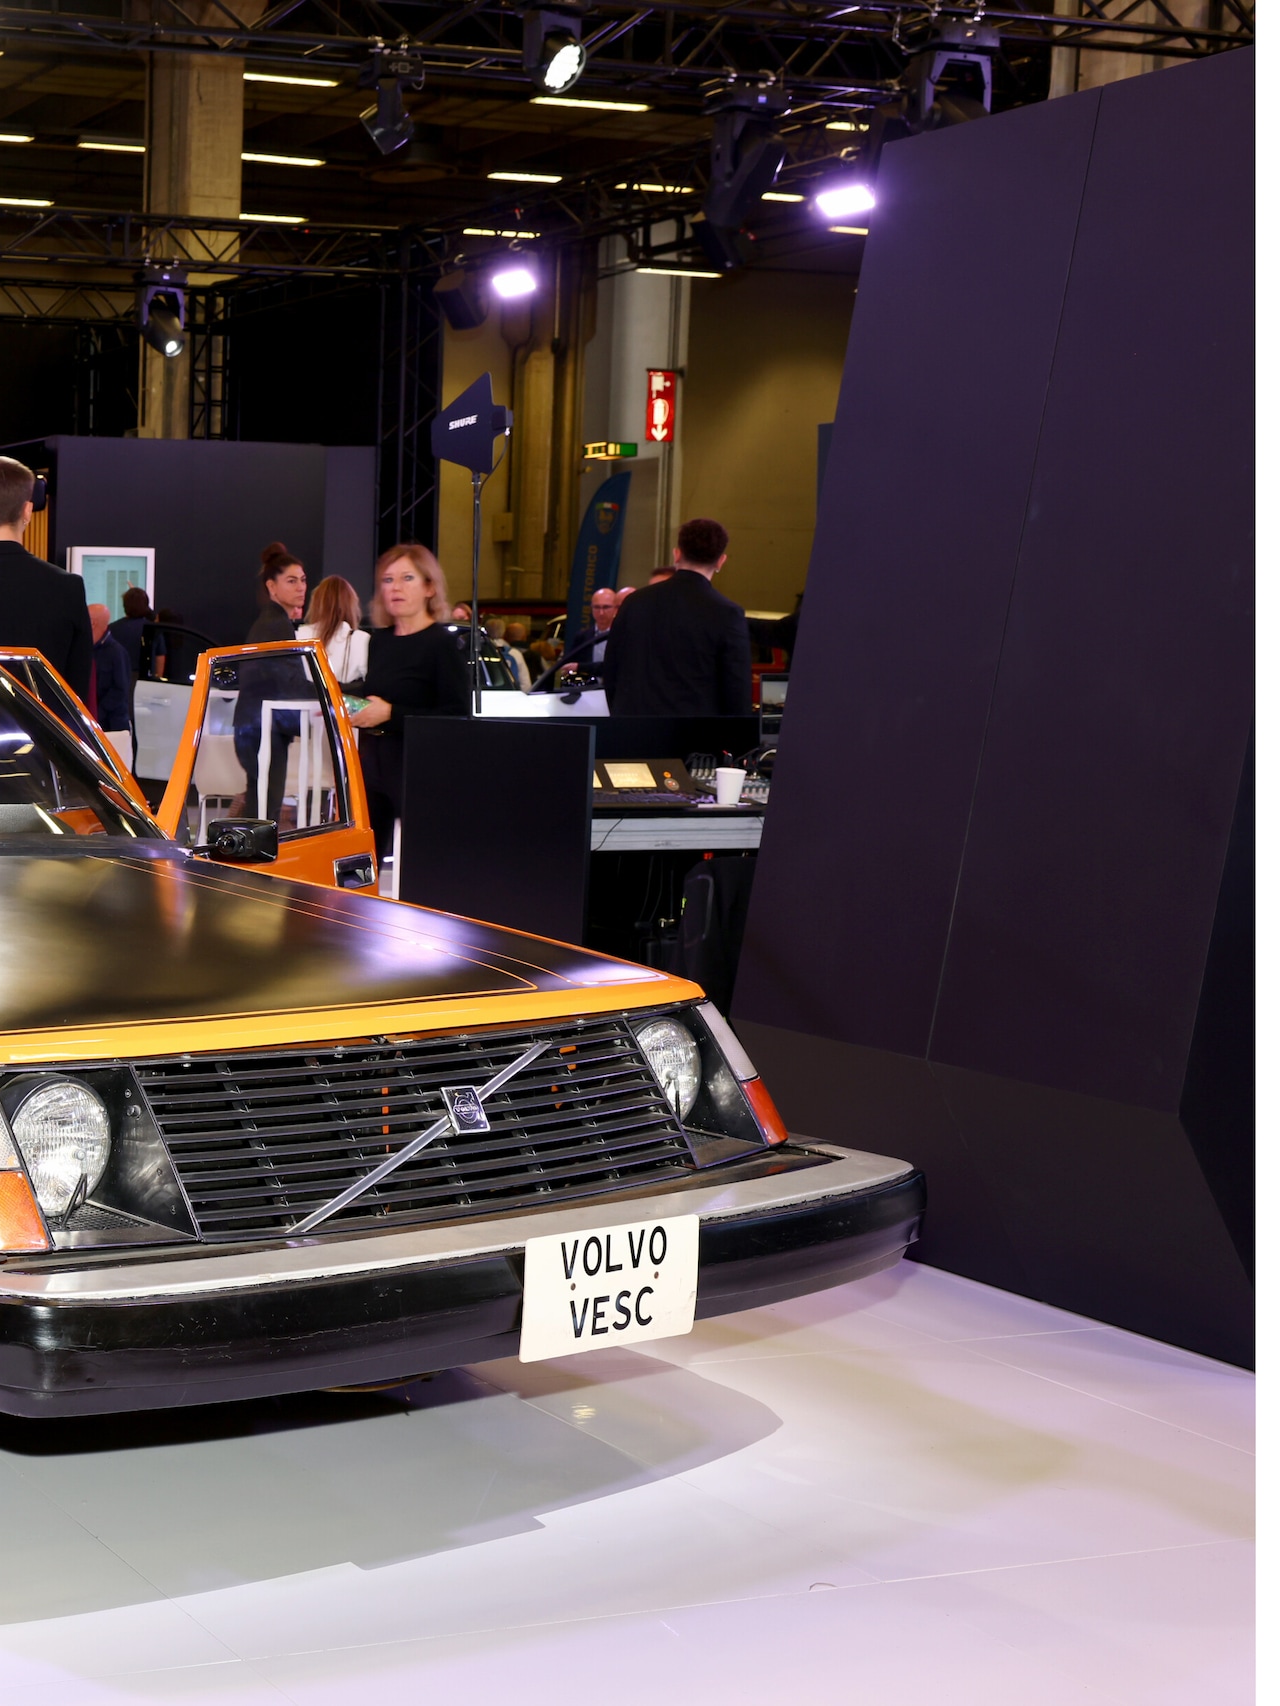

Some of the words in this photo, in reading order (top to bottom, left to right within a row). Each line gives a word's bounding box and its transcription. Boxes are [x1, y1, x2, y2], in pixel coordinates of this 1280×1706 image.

[448, 414, 478, 431] SHURE
[582, 544, 599, 602] STORICO
[560, 1225, 668, 1280] VOLVO
[569, 1286, 655, 1339] VESC
